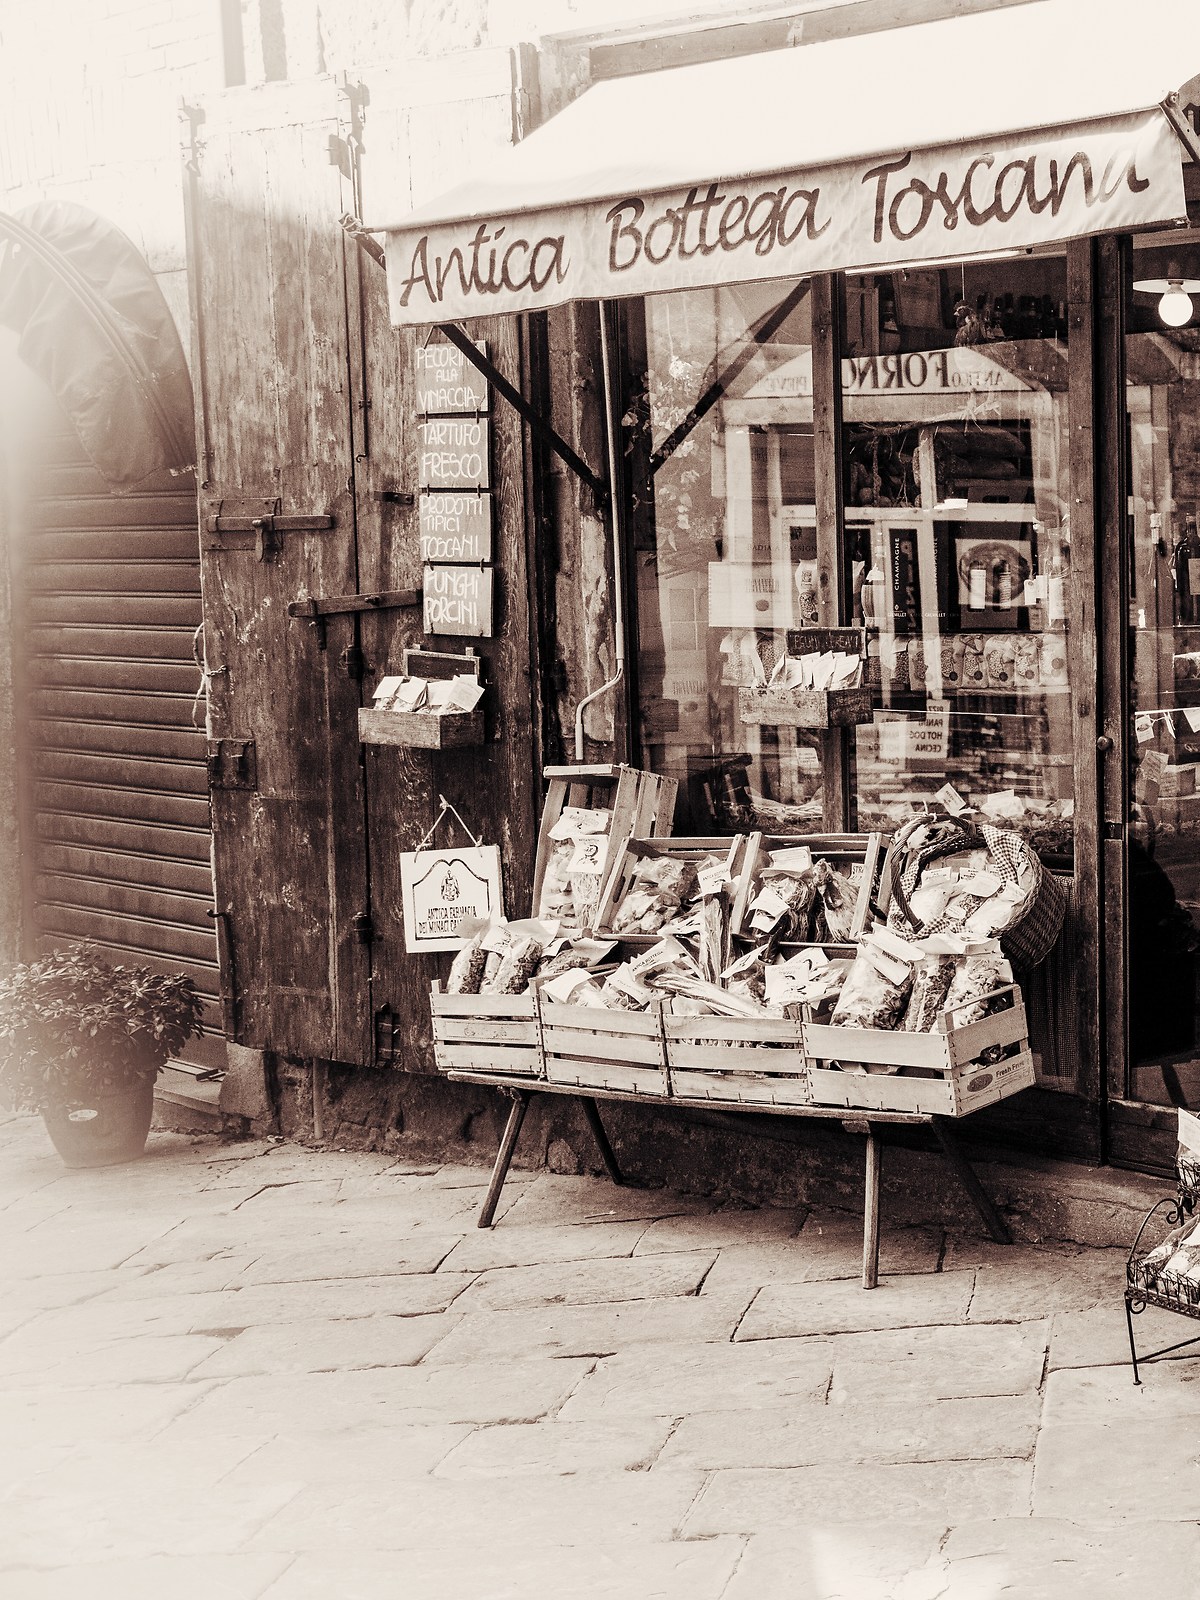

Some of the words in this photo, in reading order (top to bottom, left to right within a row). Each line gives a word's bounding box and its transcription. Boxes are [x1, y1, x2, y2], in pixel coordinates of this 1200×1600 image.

[398, 223, 571, 308] Antica
[604, 182, 830, 274] Bottega
[863, 149, 1150, 244] Toscana
[415, 346, 475, 369] PECORI
[436, 368, 459, 382] ALLA
[418, 386, 480, 411] VINACCIA
[417, 423, 481, 446] TARTUFO
[422, 452, 482, 478] FRESCO
[421, 496, 483, 515] PRODOTTI
[423, 515, 460, 533] TIPICI
[421, 535, 479, 558] TOSCANI
[425, 597, 478, 626] PORCINI
[427, 907, 449, 920] ANTICA
[995, 1067, 1012, 1078] Fresh
